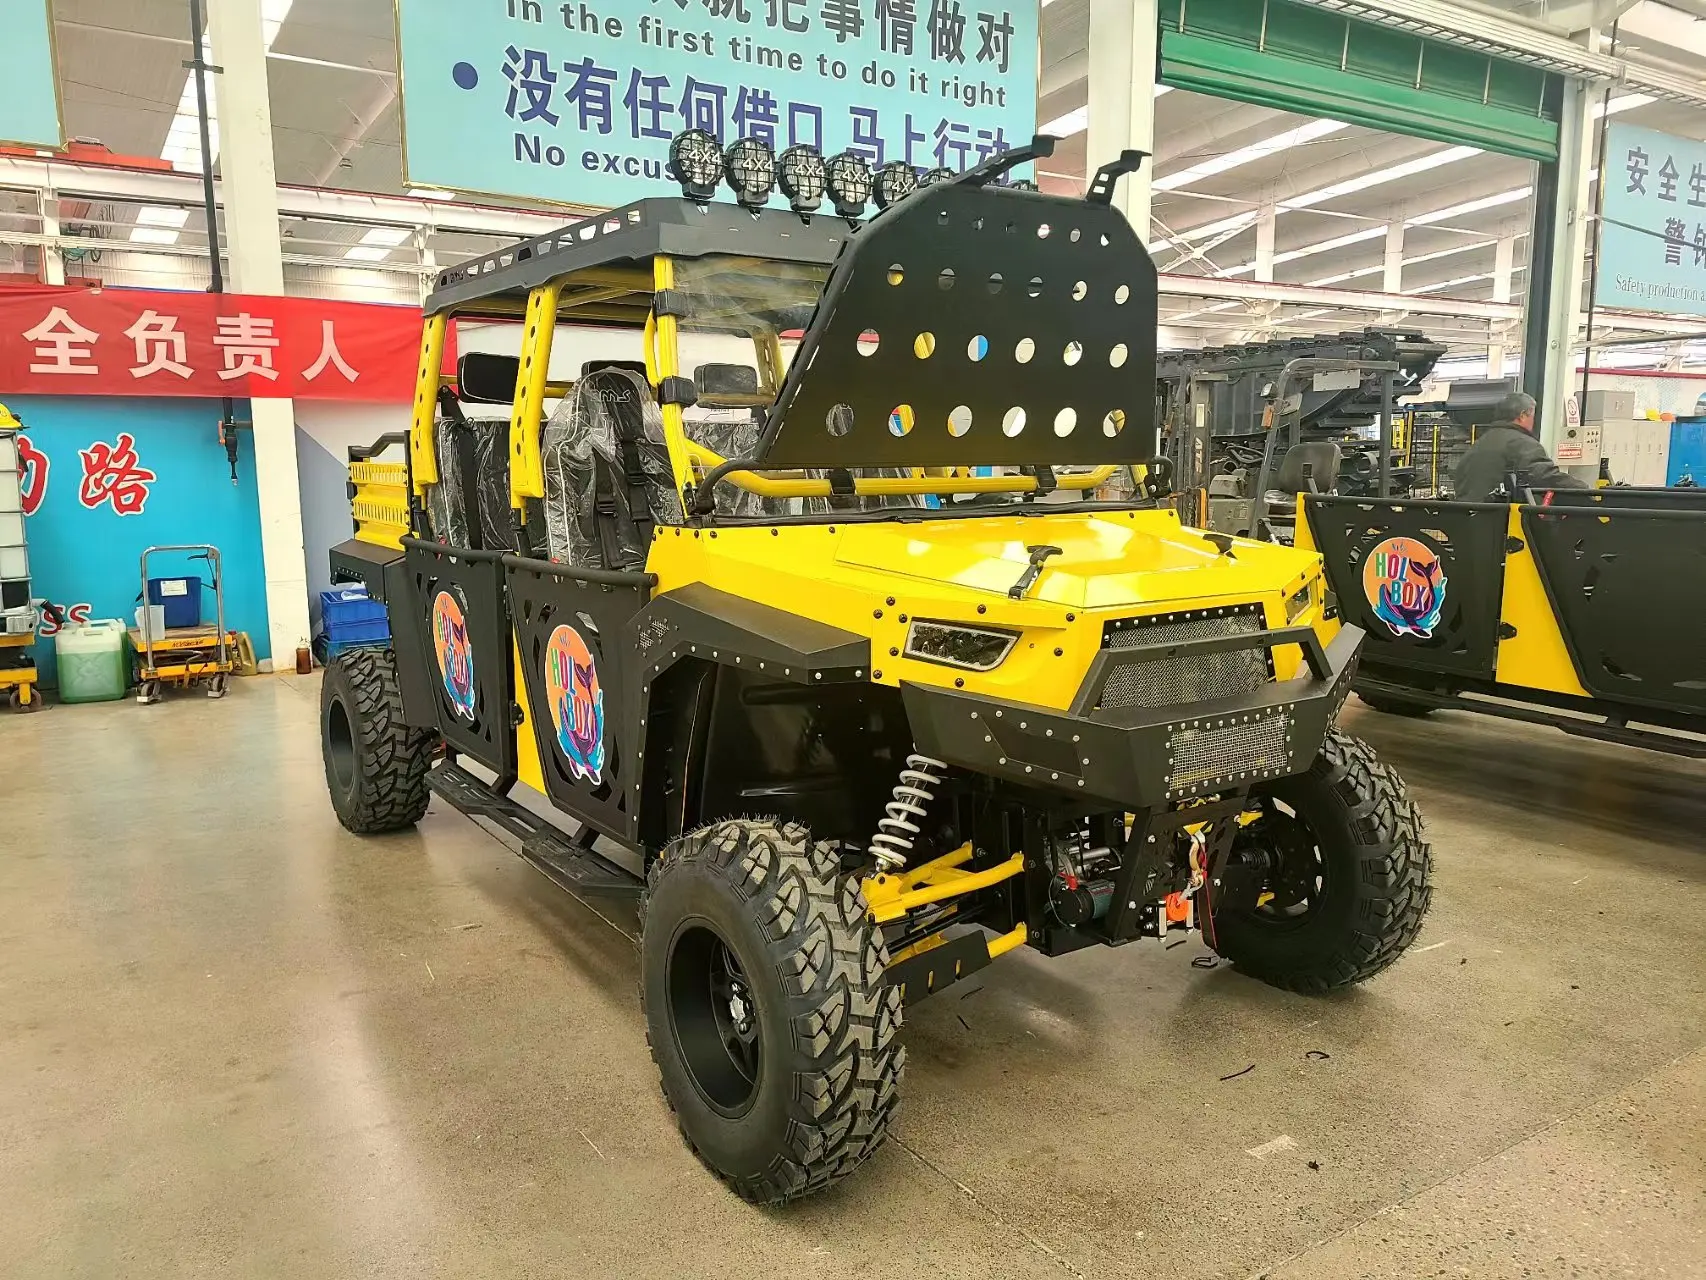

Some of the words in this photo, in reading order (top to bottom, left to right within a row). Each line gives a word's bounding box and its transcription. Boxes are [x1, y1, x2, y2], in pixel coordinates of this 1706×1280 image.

[560, 3, 624, 38] the
[638, 16, 715, 56] first
[728, 36, 803, 71] time
[816, 53, 847, 79] to
[861, 60, 896, 88] do
[909, 67, 929, 94] it
[941, 76, 1006, 108] right
[514, 132, 565, 166] No
[742, 158, 775, 172] 4X4
[794, 165, 826, 178] 4X4
[1616, 273, 1645, 297] Safety
[1648, 282, 1698, 301] production
[22, 306, 361, 383] 全负责人
